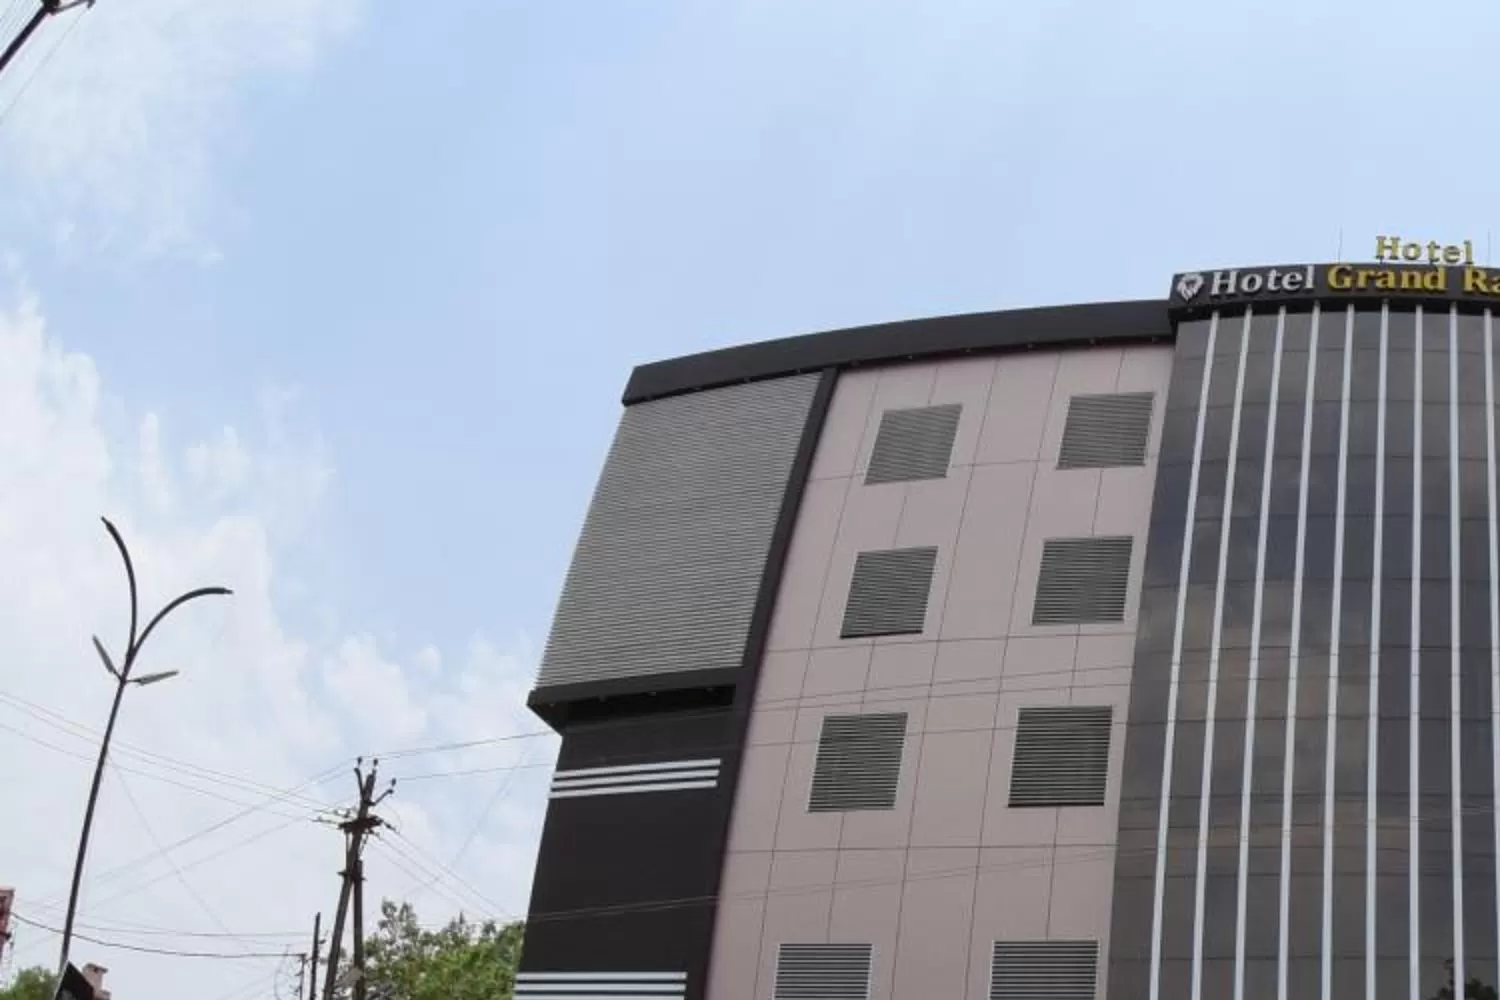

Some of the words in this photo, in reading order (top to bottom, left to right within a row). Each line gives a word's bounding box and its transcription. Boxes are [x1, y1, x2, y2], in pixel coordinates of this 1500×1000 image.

[1375, 236, 1474, 264] Hotel
[1211, 266, 1315, 296] Hotel
[1327, 265, 1446, 292] Grand
